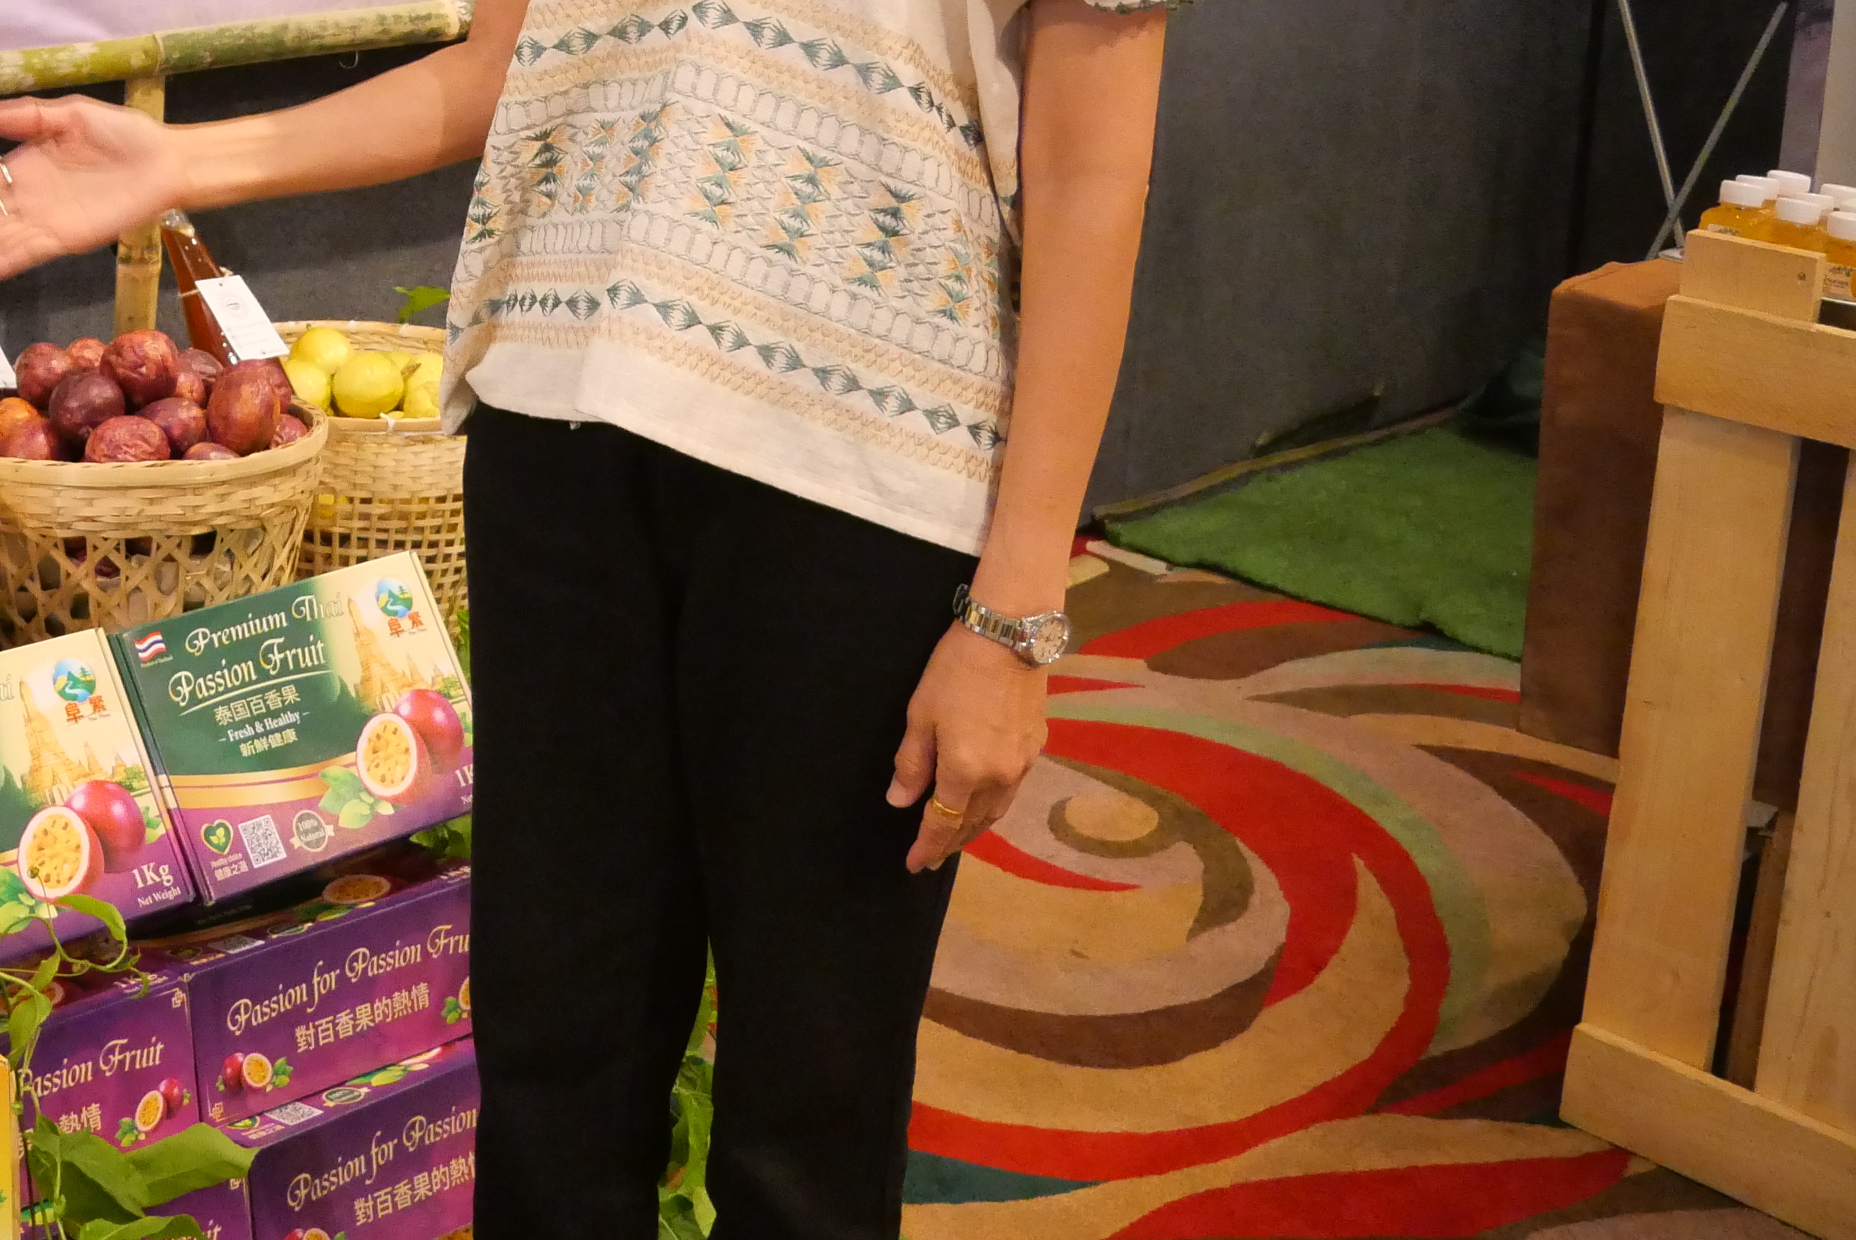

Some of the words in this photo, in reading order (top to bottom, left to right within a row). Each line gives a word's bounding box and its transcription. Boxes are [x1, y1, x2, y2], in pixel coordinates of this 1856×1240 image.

[185, 613, 289, 656] Premium
[292, 592, 345, 621] Thai
[168, 658, 257, 707] Passion
[259, 634, 326, 675] Fruit
[213, 684, 301, 726] 泰国百香果
[227, 724, 254, 742] Fresh
[255, 720, 264, 732] &
[264, 711, 301, 730] Healthy
[455, 764, 473, 787] 1K
[131, 862, 174, 889] 1Kg
[137, 895, 153, 908] Net
[153, 885, 182, 903] Weight
[226, 984, 307, 1036] Passion
[306, 960, 340, 1013] for
[345, 940, 421, 983] Passion
[426, 924, 470, 958] Fru
[295, 982, 430, 1053] 對百香果的熱情
[99, 1036, 165, 1076] Fruit
[287, 1156, 366, 1212] Passion
[365, 1131, 398, 1185] for
[403, 1106, 477, 1152] Passion
